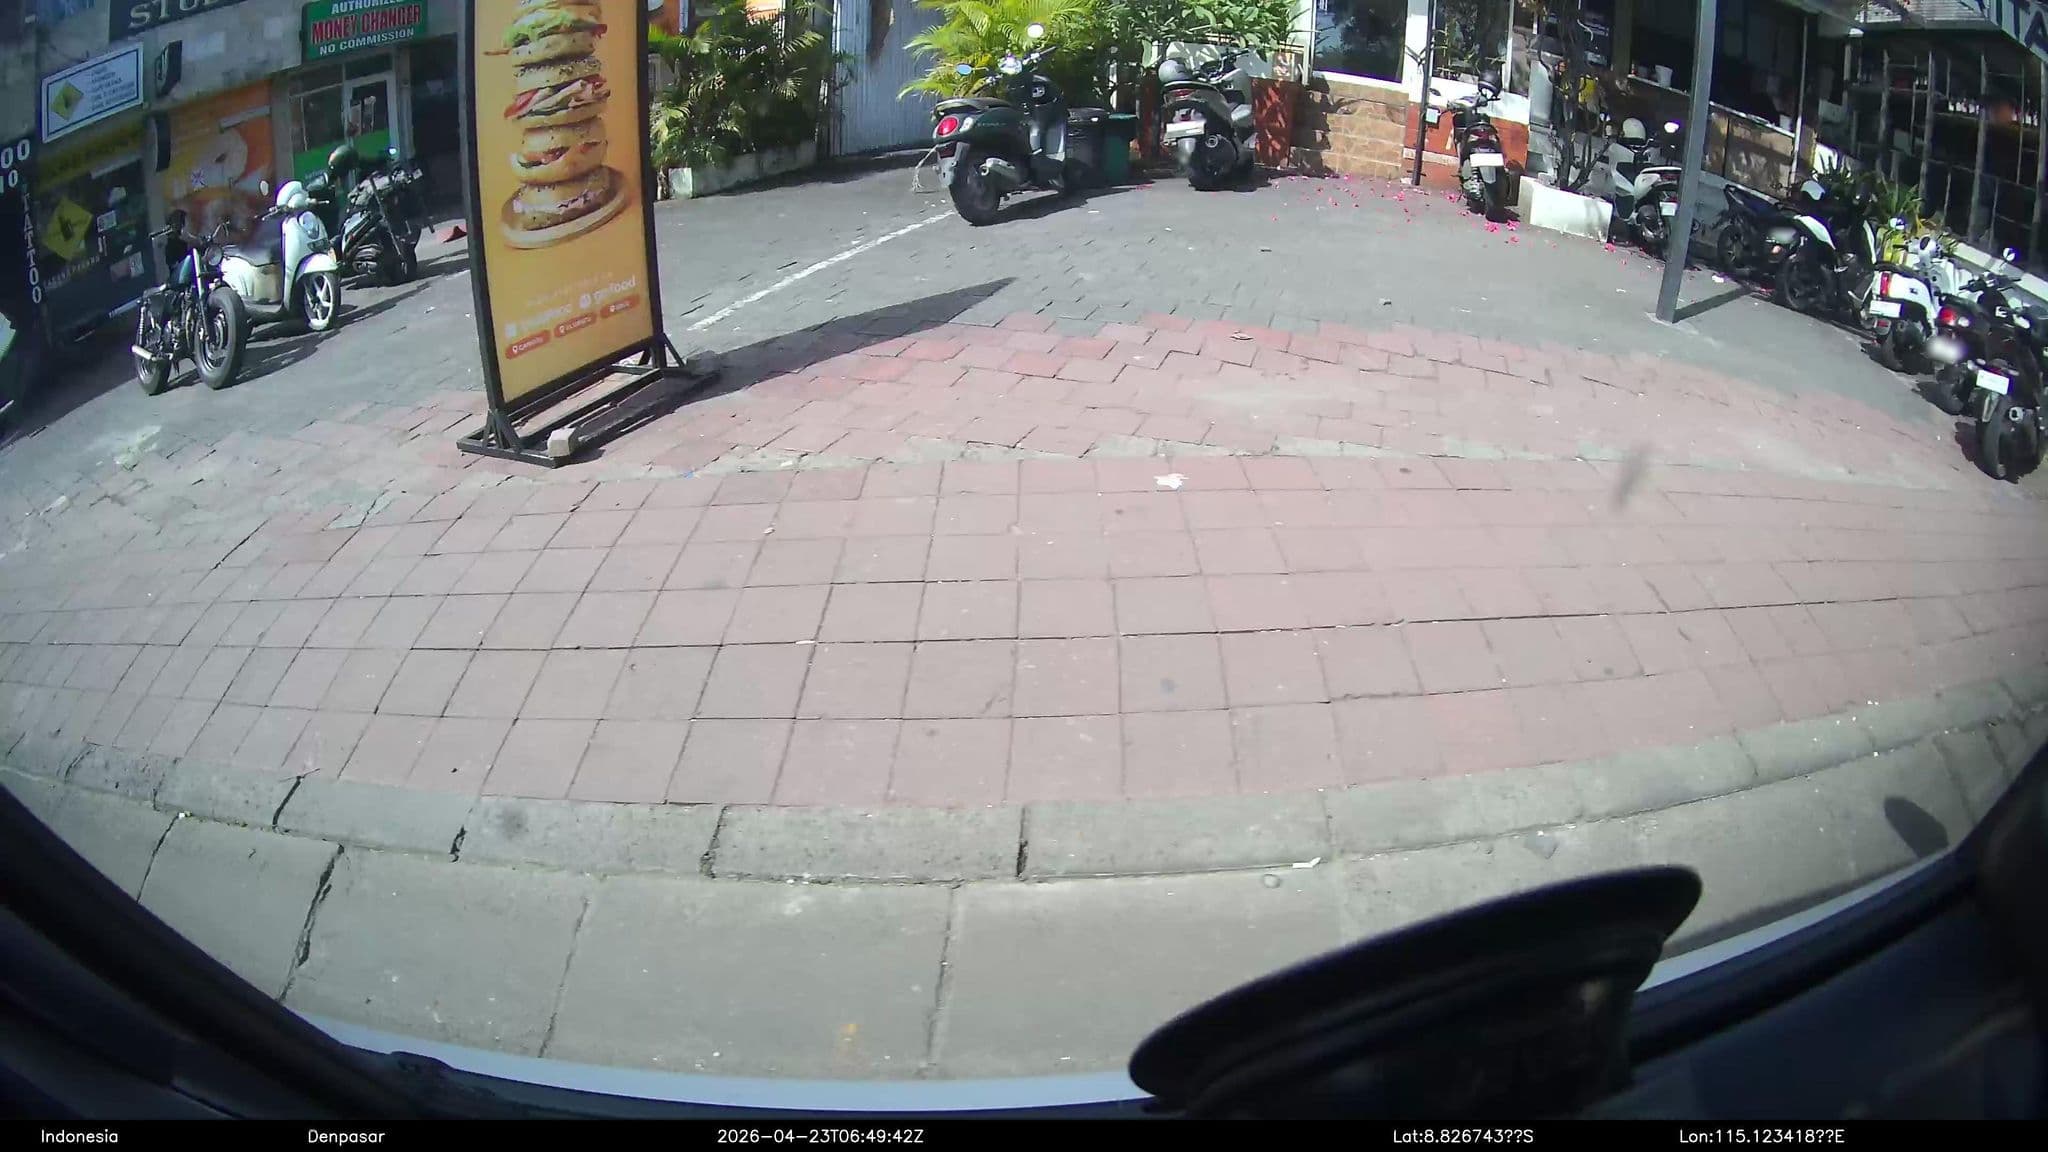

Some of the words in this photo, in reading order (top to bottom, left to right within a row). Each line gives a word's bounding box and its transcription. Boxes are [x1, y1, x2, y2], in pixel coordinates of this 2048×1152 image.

[311, 13, 357, 45] MONEY
[320, 43, 336, 55] NO
[340, 27, 414, 50] COMMISSION
[23, 192, 42, 304] TATTOO
